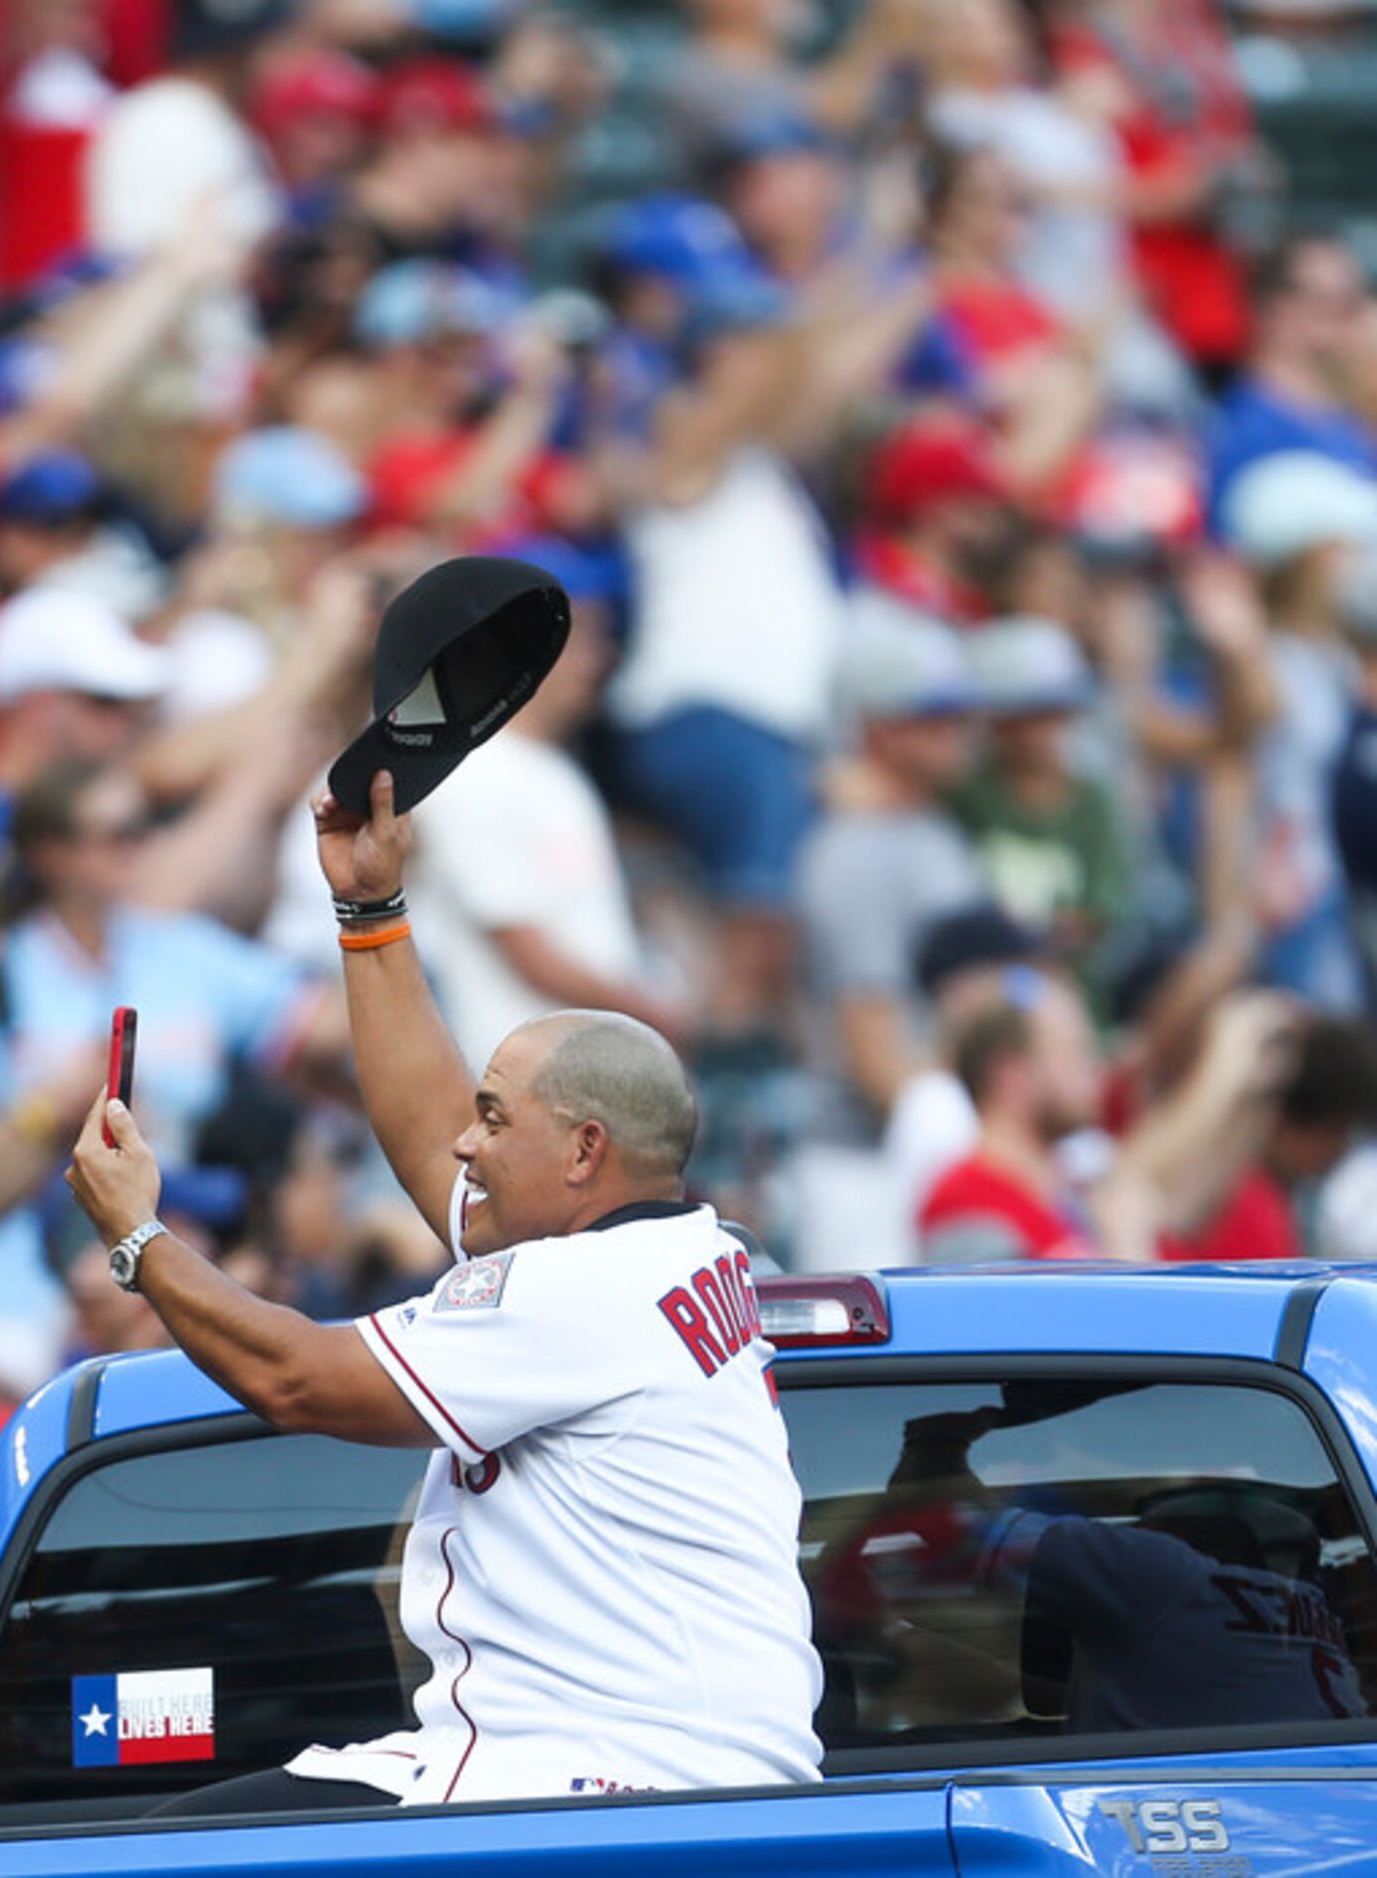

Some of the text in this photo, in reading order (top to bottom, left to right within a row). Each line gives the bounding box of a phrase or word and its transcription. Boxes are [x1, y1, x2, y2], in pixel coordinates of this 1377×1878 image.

[169, 1693, 214, 1715] HERE
[118, 1713, 214, 1740] LIVES HERE
[1097, 1799, 1230, 1853] TSS
